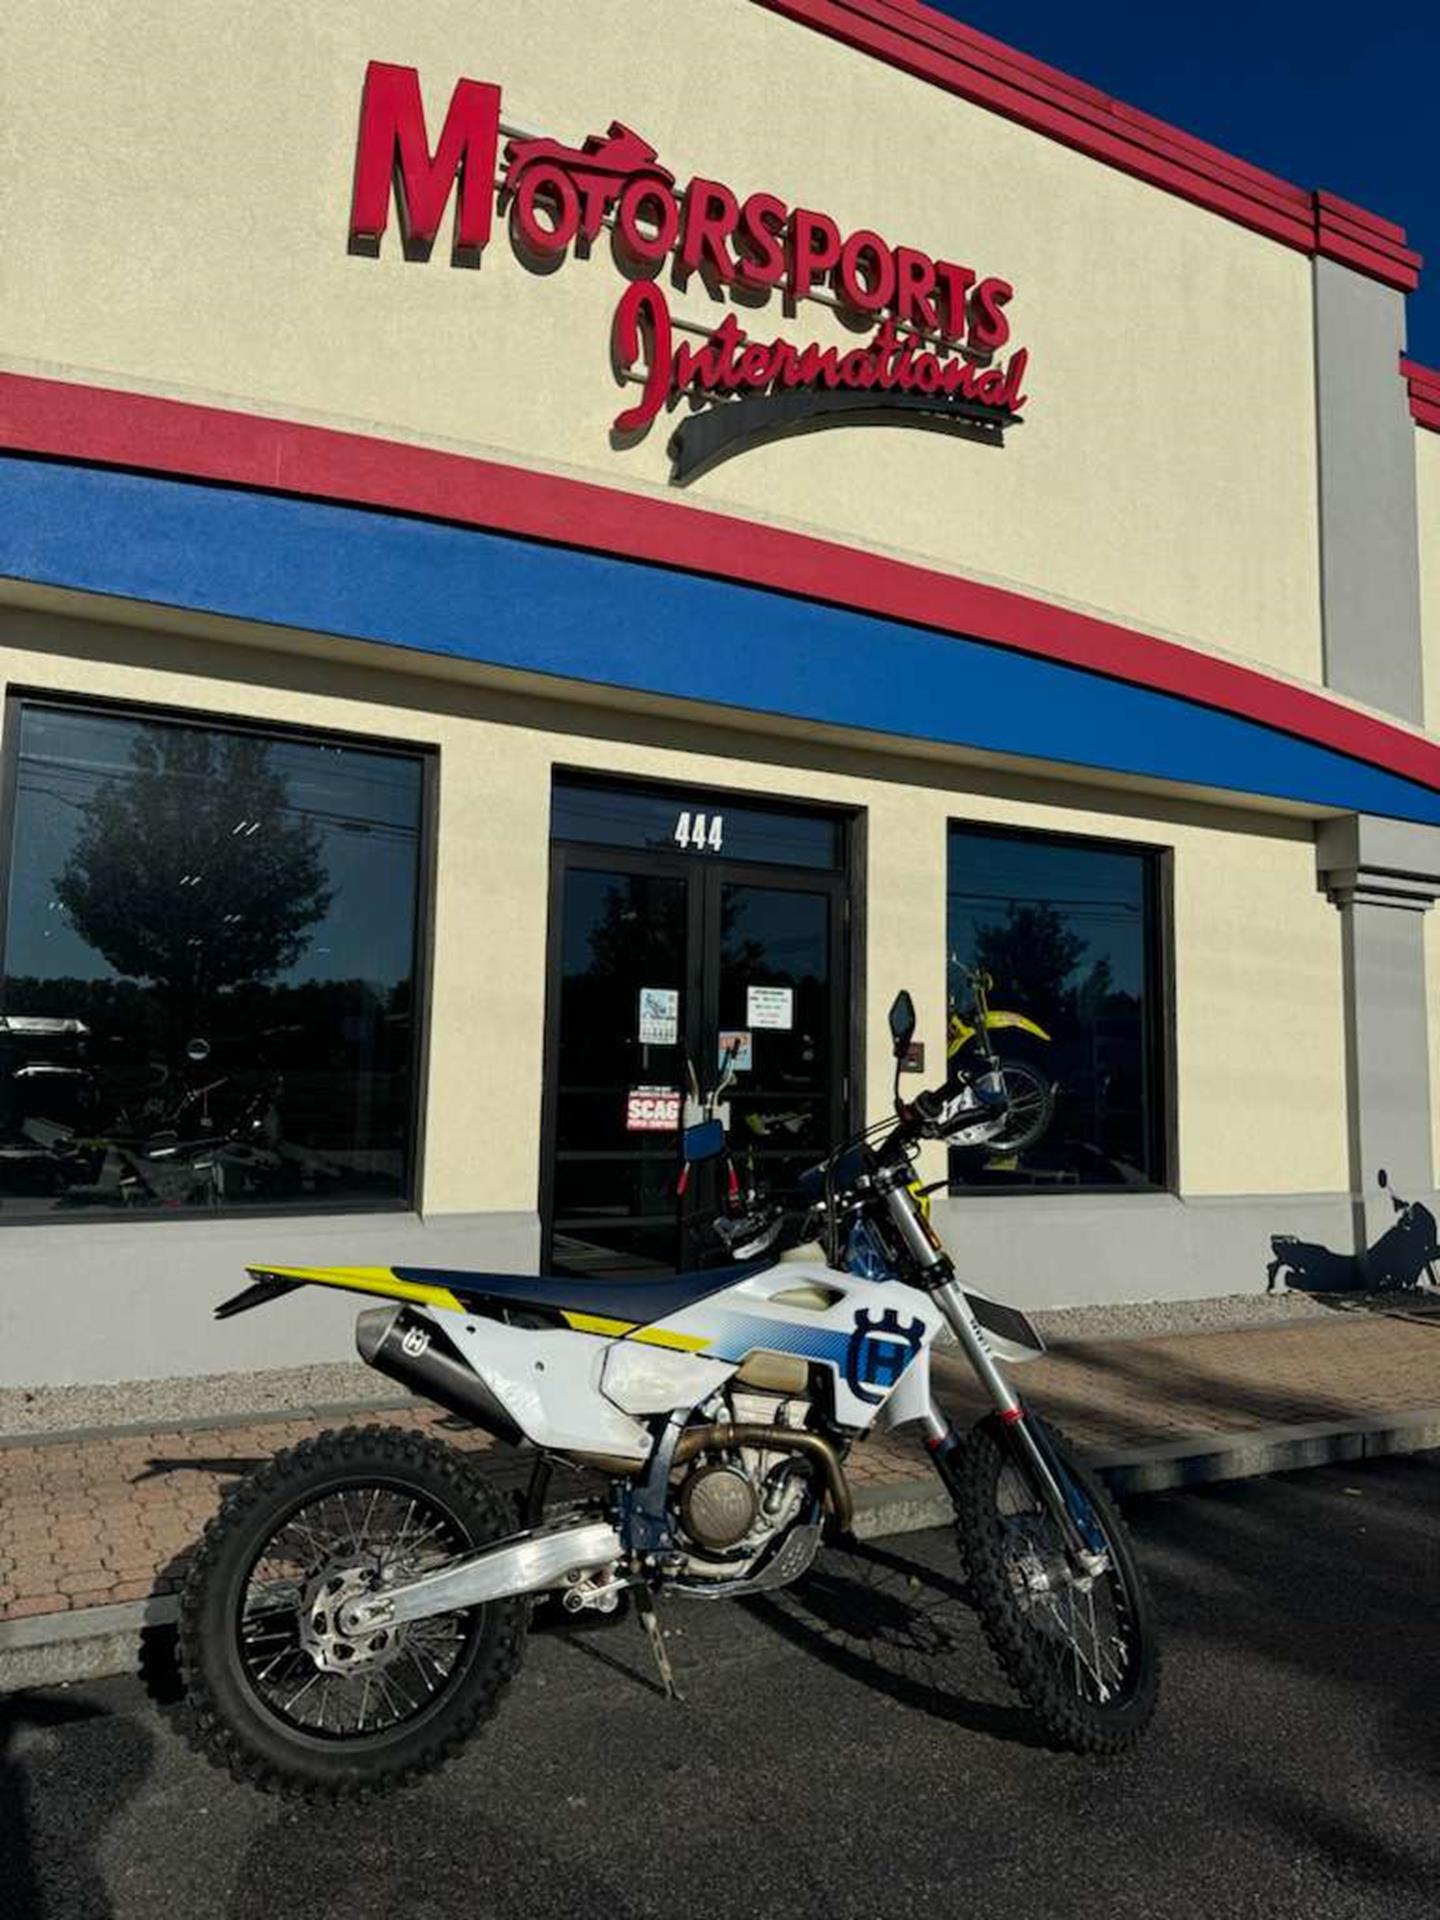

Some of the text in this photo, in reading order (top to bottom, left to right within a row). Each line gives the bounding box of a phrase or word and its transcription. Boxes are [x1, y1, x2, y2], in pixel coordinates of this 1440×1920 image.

[614, 278, 1029, 433] International
[674, 811, 723, 851] 444
[628, 1099, 679, 1120] SCAG
